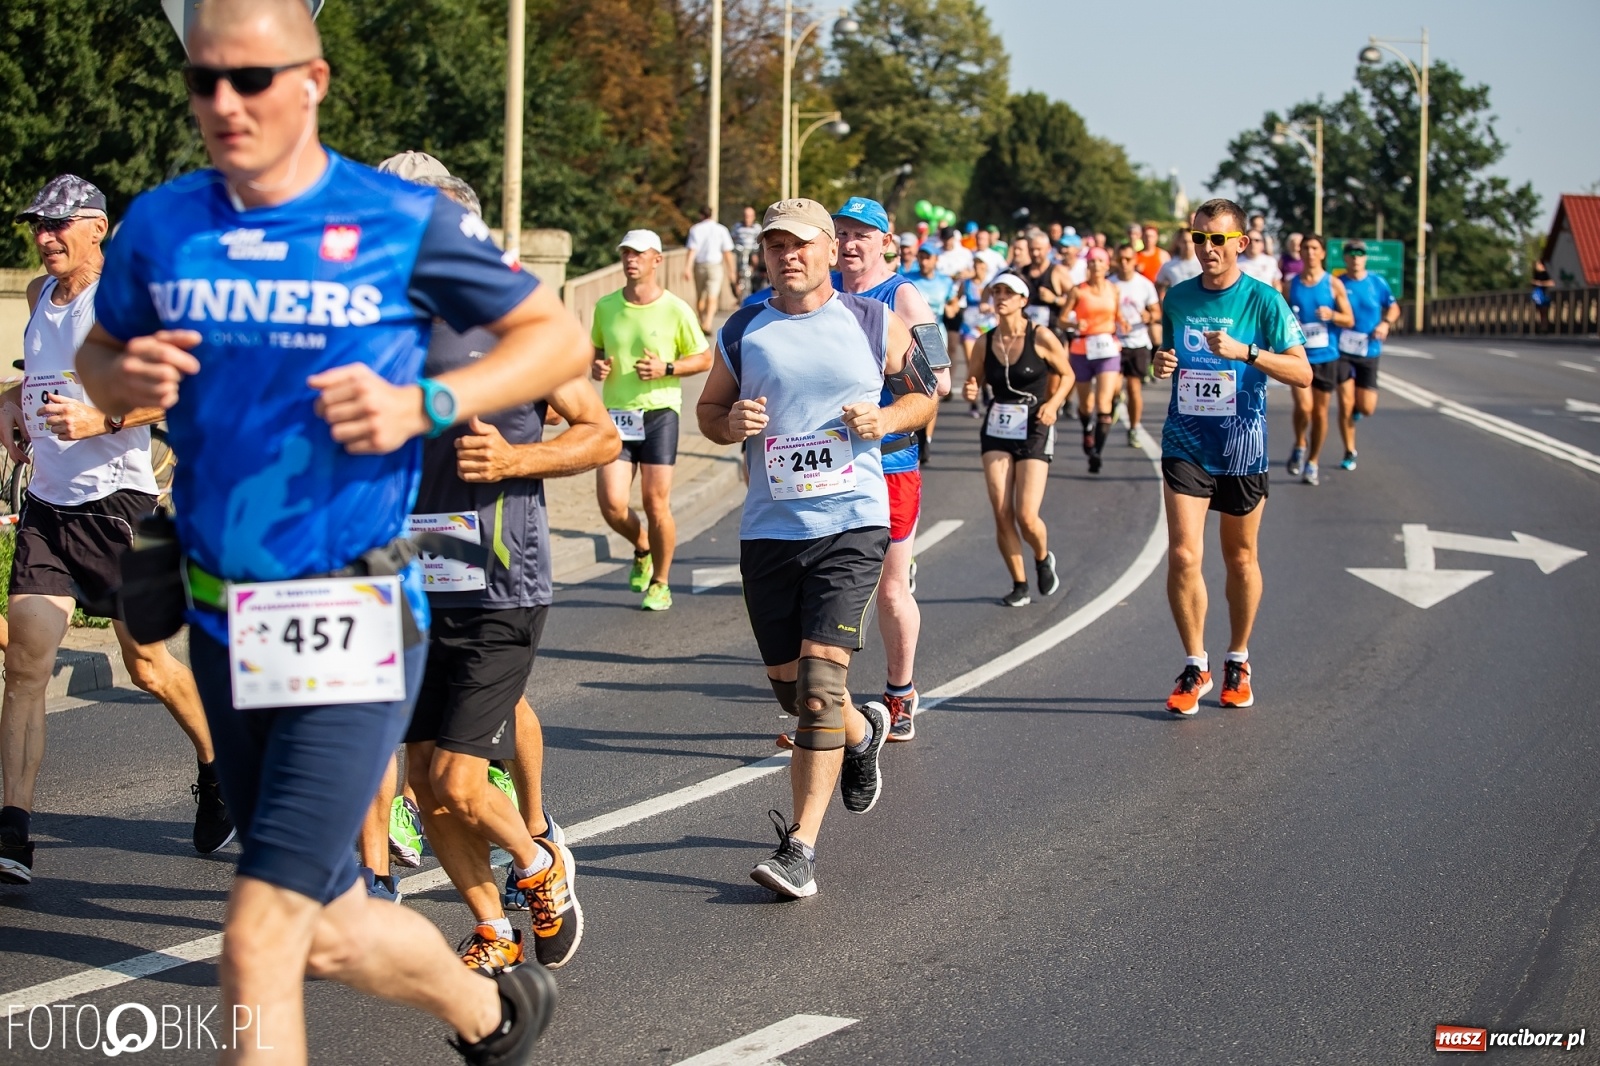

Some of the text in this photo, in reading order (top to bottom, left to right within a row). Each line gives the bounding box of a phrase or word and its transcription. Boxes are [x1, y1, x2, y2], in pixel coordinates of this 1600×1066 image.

[268, 334, 326, 350] TEAM
[1191, 356, 1222, 365] RACIBÓRZ
[1194, 382, 1221, 398] 124
[614, 415, 633, 426] 156
[999, 413, 1012, 424] 57
[790, 447, 833, 472] 244
[283, 615, 355, 654] 457
